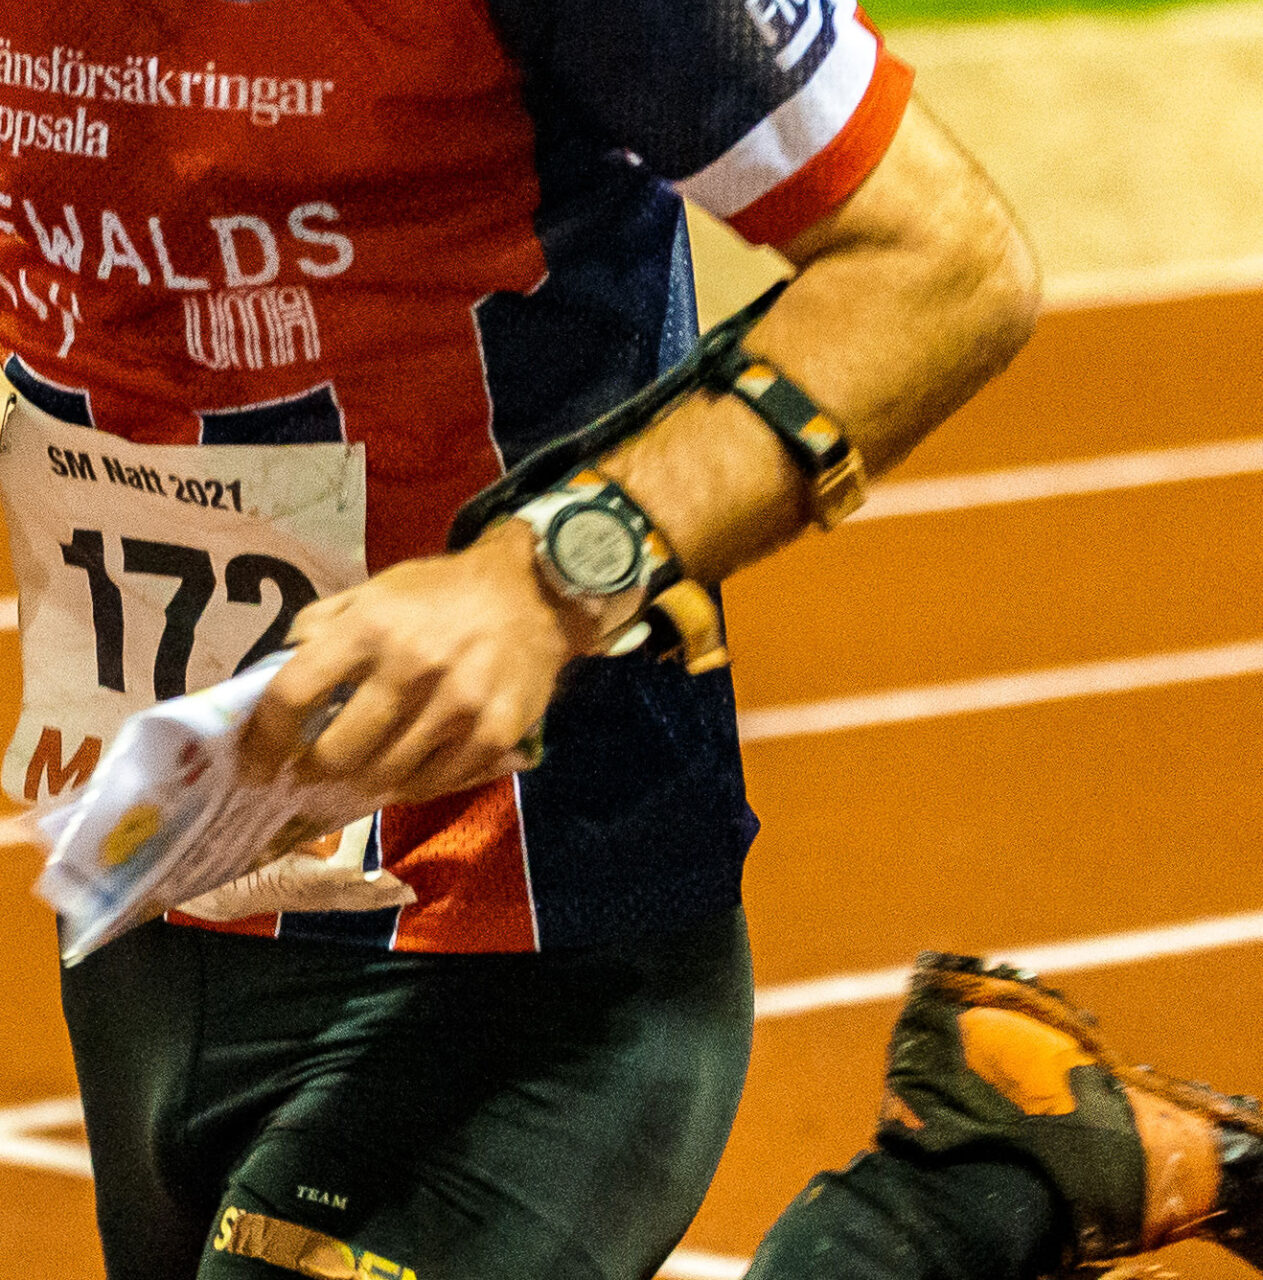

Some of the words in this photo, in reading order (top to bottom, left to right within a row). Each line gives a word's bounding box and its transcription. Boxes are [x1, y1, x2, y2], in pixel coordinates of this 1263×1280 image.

[47, 445, 97, 483] SM
[102, 457, 166, 498] Natt
[168, 475, 243, 512] 2021
[59, 528, 319, 702] 172
[297, 1184, 349, 1211] TEAM
